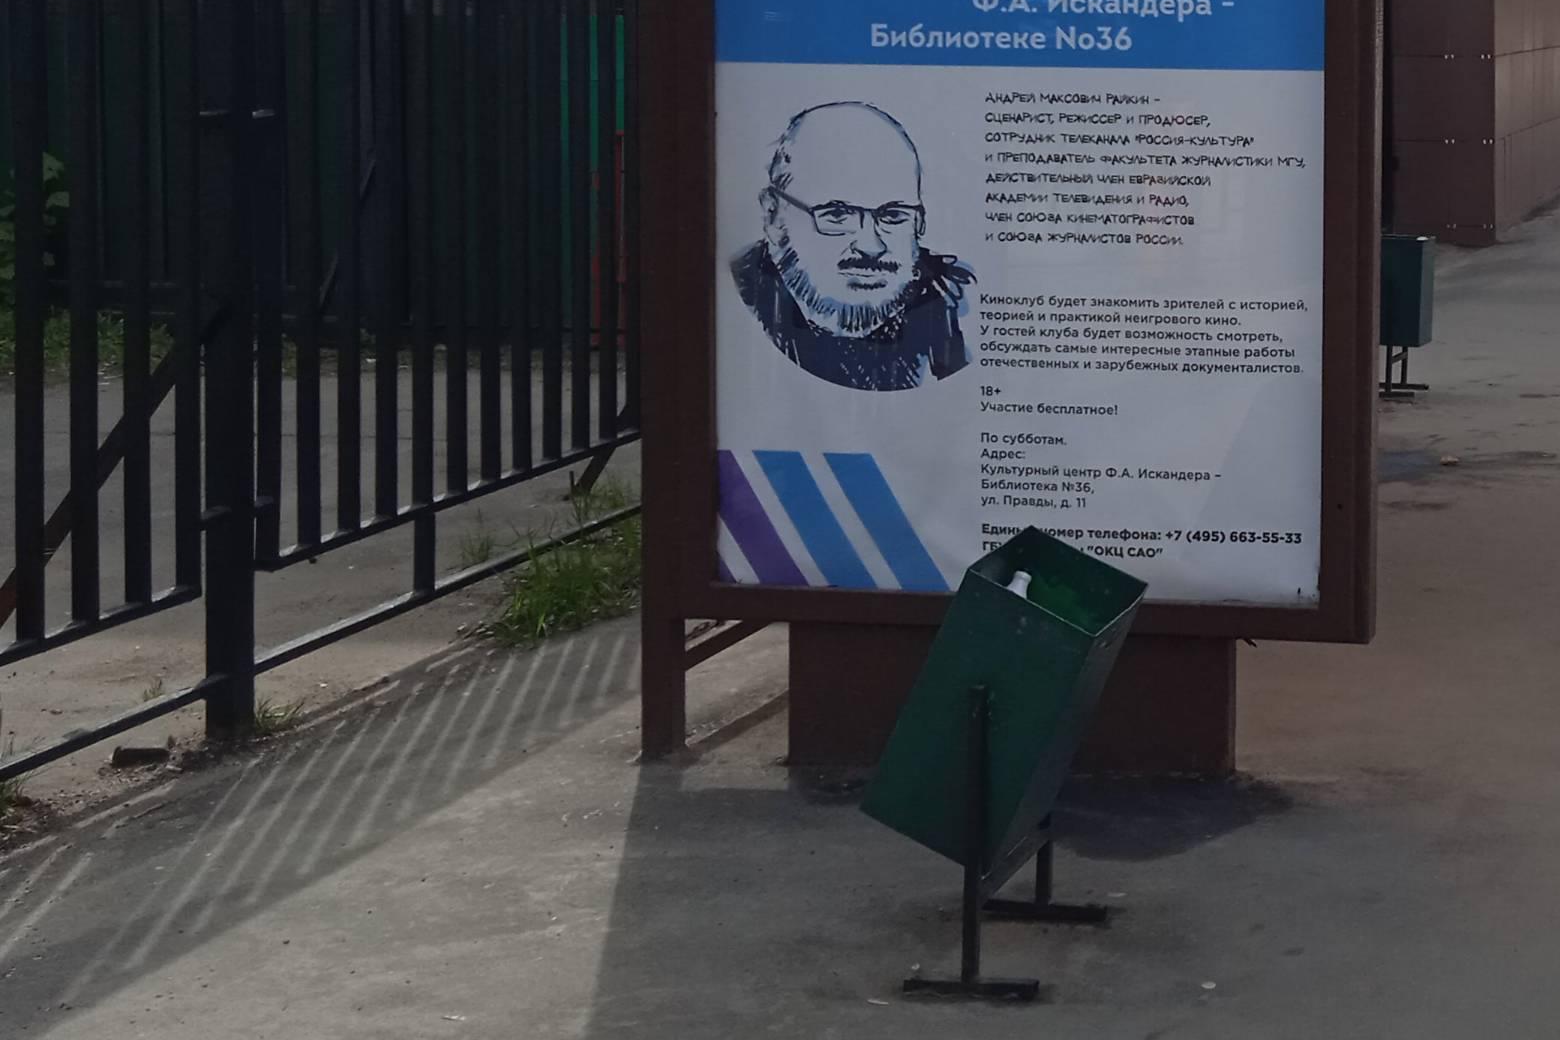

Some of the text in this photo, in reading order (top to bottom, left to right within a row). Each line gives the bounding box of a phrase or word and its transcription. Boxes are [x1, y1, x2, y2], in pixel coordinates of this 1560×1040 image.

[872, 24, 1046, 49] Библиотеке
[985, 92, 1035, 104] АНДРЕЙ
[1040, 93, 1101, 104] МАКСОВИЧ
[1106, 93, 1149, 105] РАЙКИН
[985, 112, 1210, 127] СЦЕНАРИСТ, РЕЖИССЕР И ПРОДЮСЕР,
[985, 132, 1055, 144] СОТРУДНИК
[1060, 134, 1130, 145] ТЕЛЕКАНАЛА
[985, 152, 1305, 168] И ПРЕПОДАВАТЕЛЬ ФАКУЛЬТЕТА ЖУРНАЛИСТИКИ МГУ,
[986, 173, 1211, 186] ДЕЙСТВИТЕЛЬНЫЙ ЧЛЕН ЕВРАЗИЙСКОЙ
[986, 193, 1189, 207] АКАДЕМИИ ТЕЛЕВИДЕНИЯ И РАДИО,
[985, 213, 1194, 225] ЧЛЕН СОЮЗА КИНЕМАТОГРАФИСТОВ
[986, 232, 1183, 245] И СОЮЗА ЖУРНАЛИСТОВ РОССИИ.
[980, 294, 1307, 312] Киноклуб будет знакомить зрителей с историей,
[980, 311, 1240, 325] теорией и практикой неигрового кино.
[980, 325, 1282, 343] У гостей клуба будет возможность смотреть,
[980, 341, 1295, 359] обсуждать самые интересные этапные работы
[980, 358, 1078, 368] отечественных
[1096, 360, 1178, 372] зарубежных
[1182, 362, 1304, 374] документалистов.
[981, 386, 1001, 396] 18+
[981, 401, 1117, 415] Участие бесплатное!
[981, 432, 1066, 445] По субботам.
[981, 449, 1024, 460] Адрес:
[981, 464, 1059, 476] Культурный
[1064, 469, 1101, 479] центр
[1106, 468, 1133, 478] Ф.А.
[1139, 469, 1210, 480] Искандера
[982, 479, 1094, 494] Библиотека №36,
[981, 495, 1085, 509] ул. Правды, д. 11
[982, 524, 1022, 535] Един
[1087, 529, 1161, 541] телефона:
[1166, 530, 1182, 541] +7
[1186, 531, 1225, 543] (495)
[1230, 532, 1301, 544] 663-55-33
[1087, 546, 1124, 559] "ОКЦ
[1128, 547, 1163, 558] САО"
